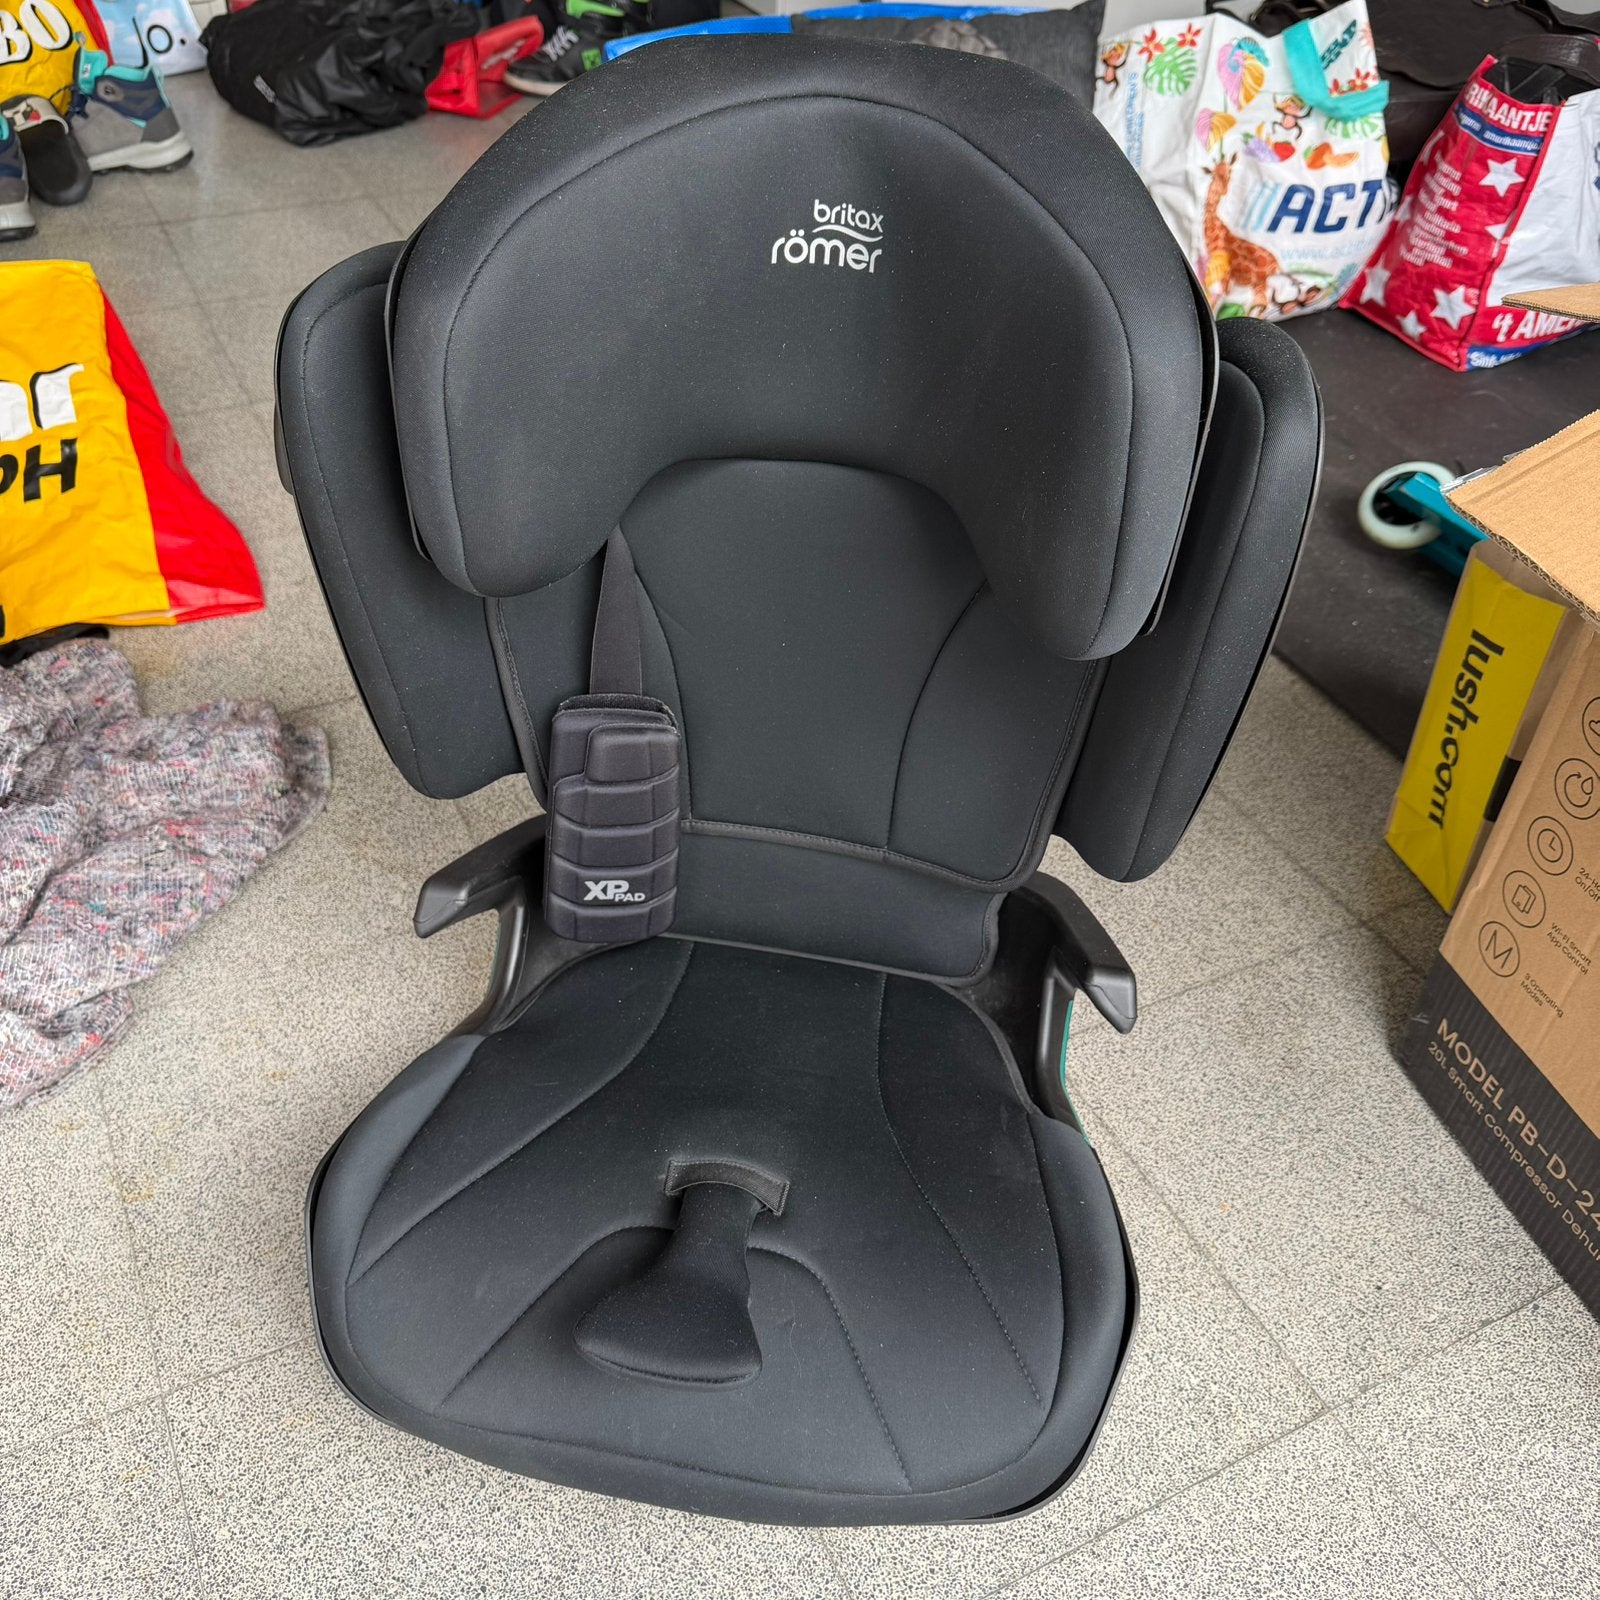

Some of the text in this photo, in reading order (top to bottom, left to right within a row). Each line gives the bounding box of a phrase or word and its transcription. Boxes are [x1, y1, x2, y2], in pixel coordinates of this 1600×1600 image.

[813, 199, 884, 233] britax
[771, 229, 883, 274] römer
[1428, 629, 1505, 830] lush.com
[583, 879, 646, 902] XP PAD
[1546, 931, 1589, 976] App Control
[1551, 922, 1592, 966] Wi-Fi Smart
[1520, 980, 1543, 1007] Modes
[1529, 979, 1565, 1019] Operating
[1437, 1018, 1504, 1111] MODEL
[1428, 1041, 1447, 1070] 20L
[1448, 1066, 1485, 1116] Smart
[1484, 1113, 1563, 1209] Compressor
